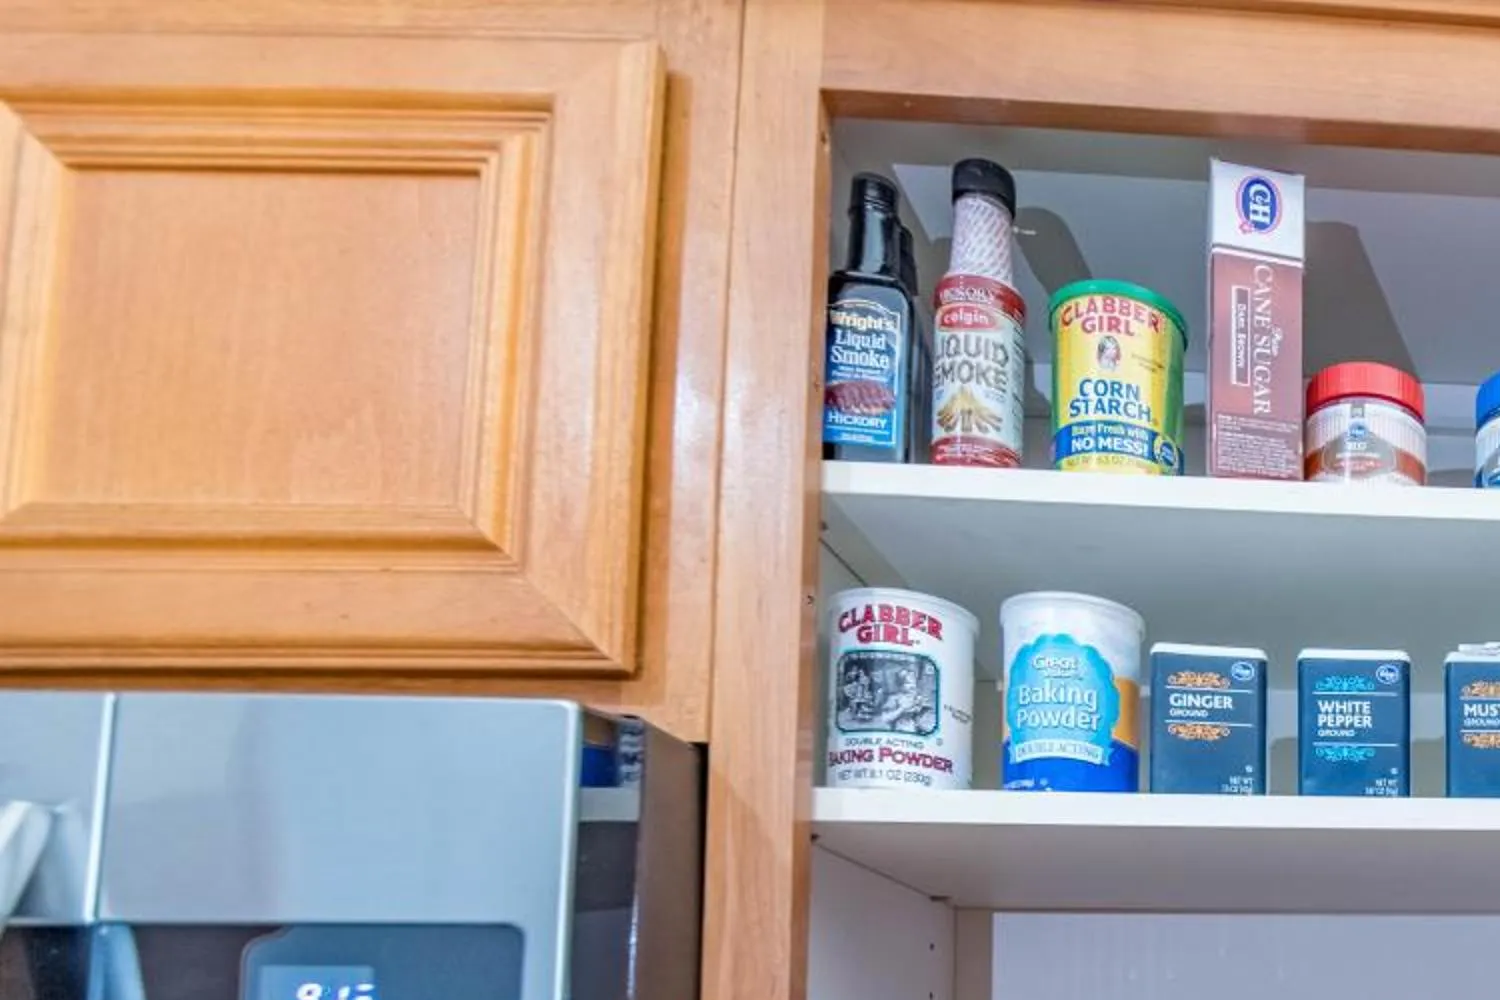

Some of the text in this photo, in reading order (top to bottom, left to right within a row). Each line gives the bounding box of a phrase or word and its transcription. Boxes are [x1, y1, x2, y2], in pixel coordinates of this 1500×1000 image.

[1060, 296, 1163, 333] CLABBER
[1081, 315, 1136, 337] GIRL
[835, 328, 887, 350] Liquid
[1253, 264, 1273, 415] CANE SUGAR
[831, 345, 890, 369] Smoke
[1078, 378, 1141, 401] CORN
[1068, 397, 1151, 423] STARCH
[1071, 436, 1096, 452] NO
[837, 603, 943, 641] CLABBER
[856, 623, 913, 646] GIRL
[1018, 680, 1098, 712] Baking
[1168, 693, 1234, 709] GINGER
[1316, 699, 1372, 714] WHITE
[1015, 706, 1101, 731] Powder
[1169, 708, 1209, 717] GROUND
[1317, 713, 1373, 728] PEPPER
[885, 737, 925, 750] ACTING
[878, 747, 953, 773] POWDER
